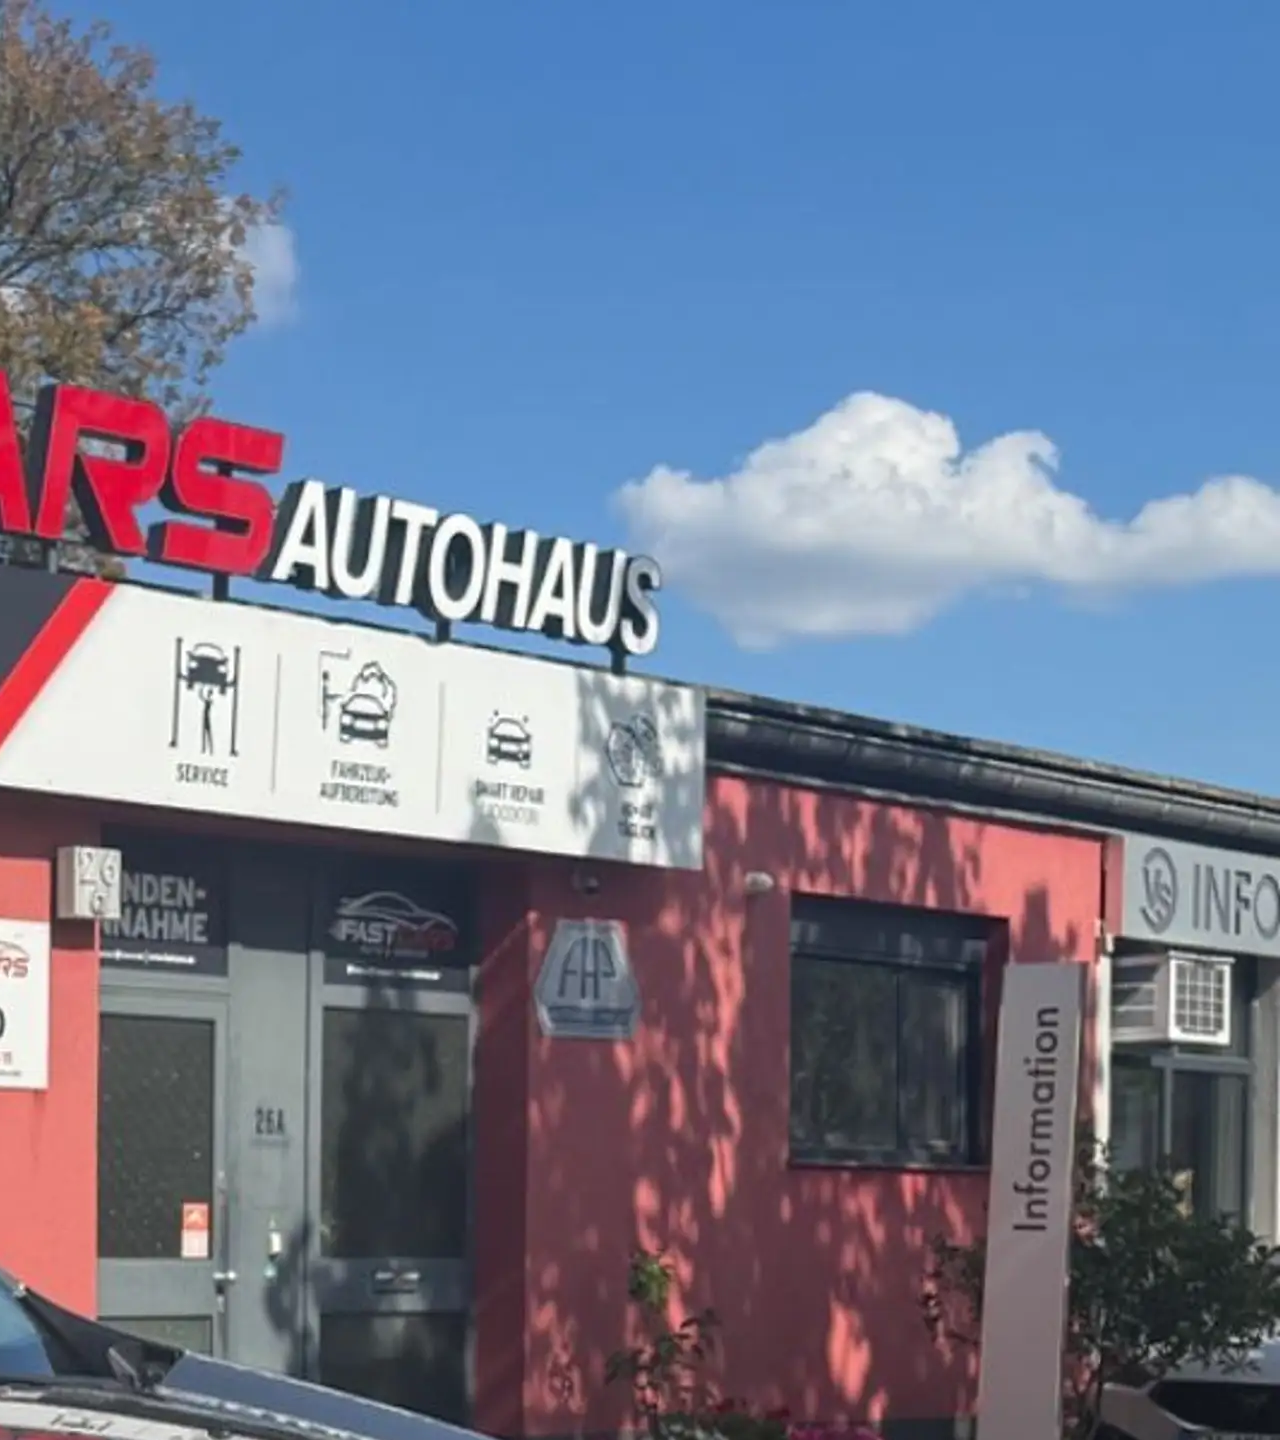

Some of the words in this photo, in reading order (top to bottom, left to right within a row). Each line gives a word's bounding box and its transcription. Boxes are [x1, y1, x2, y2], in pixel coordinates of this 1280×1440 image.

[271, 479, 662, 656] AUTOHAUS
[175, 762, 229, 787] SERVICE
[1012, 1006, 1061, 1232] Information
